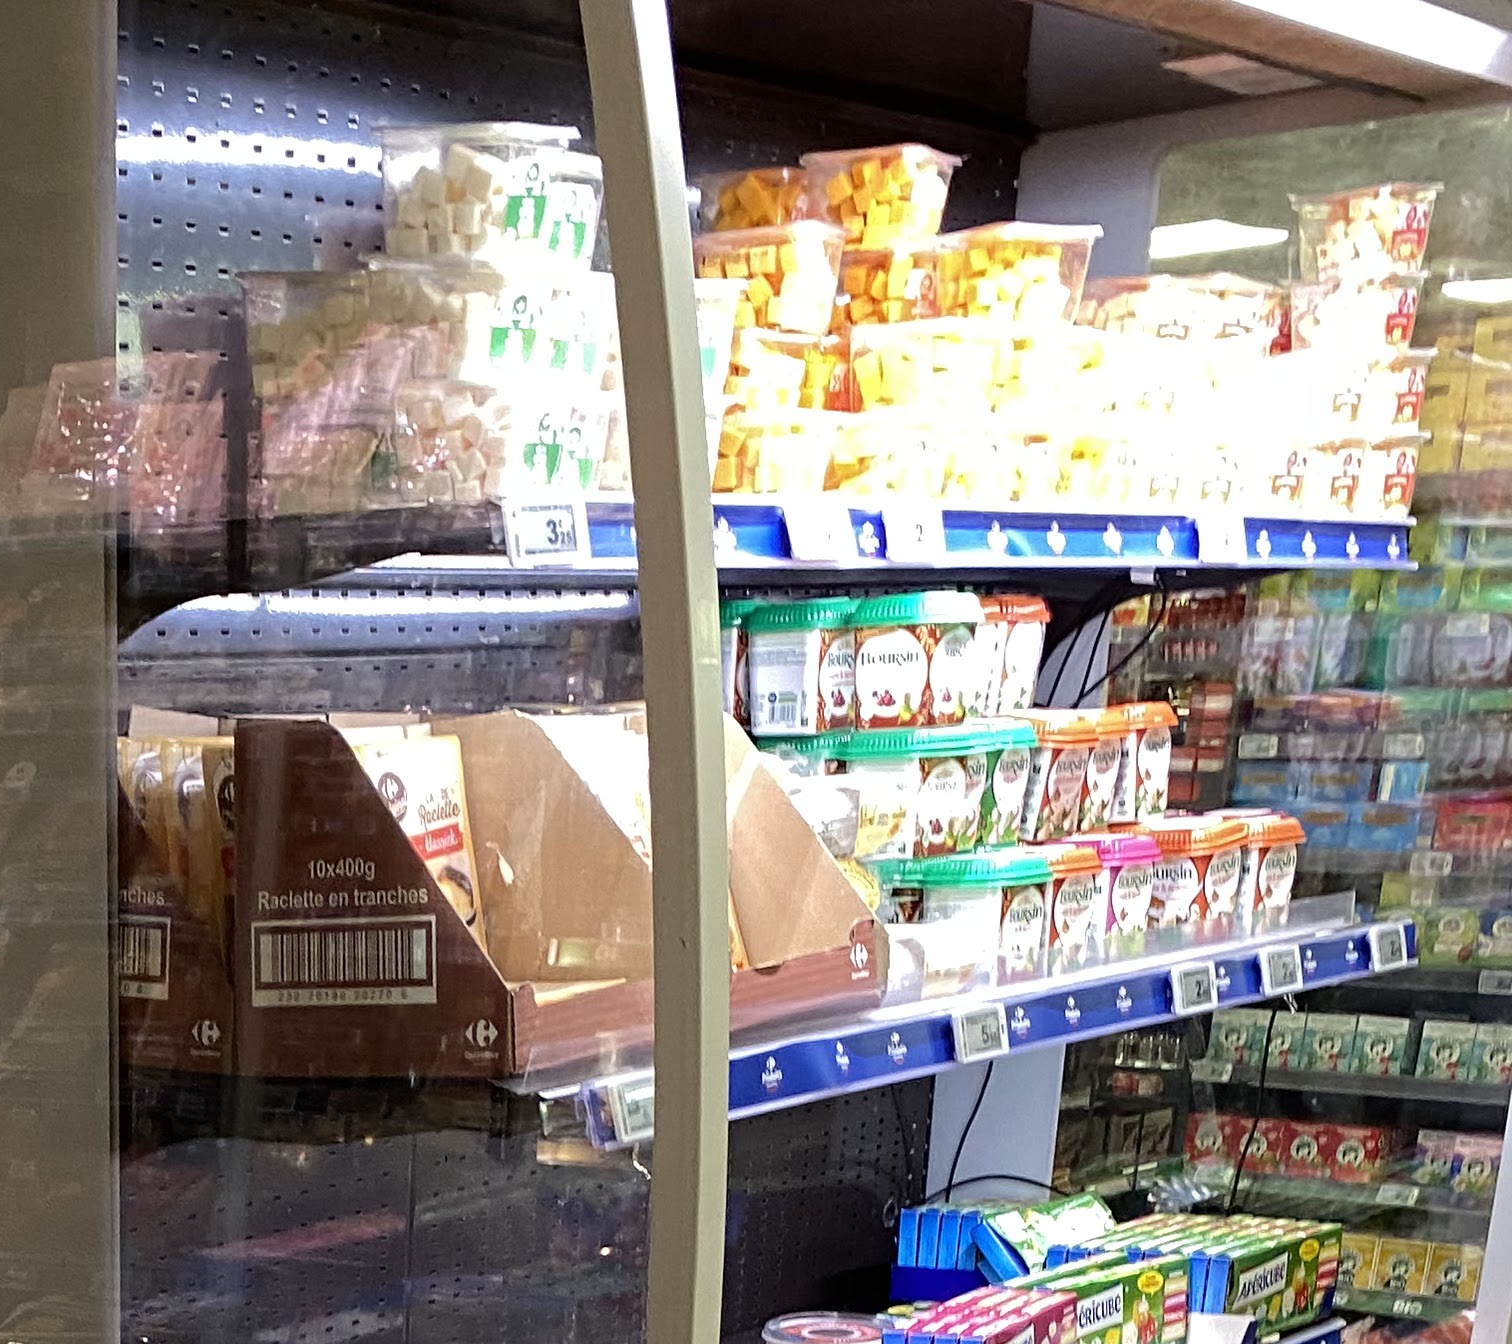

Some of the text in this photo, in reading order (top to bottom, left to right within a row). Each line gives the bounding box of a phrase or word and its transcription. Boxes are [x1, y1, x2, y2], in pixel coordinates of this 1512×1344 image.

[308, 857, 376, 882] 10x400g
[258, 886, 429, 912] Raclette en tranches
